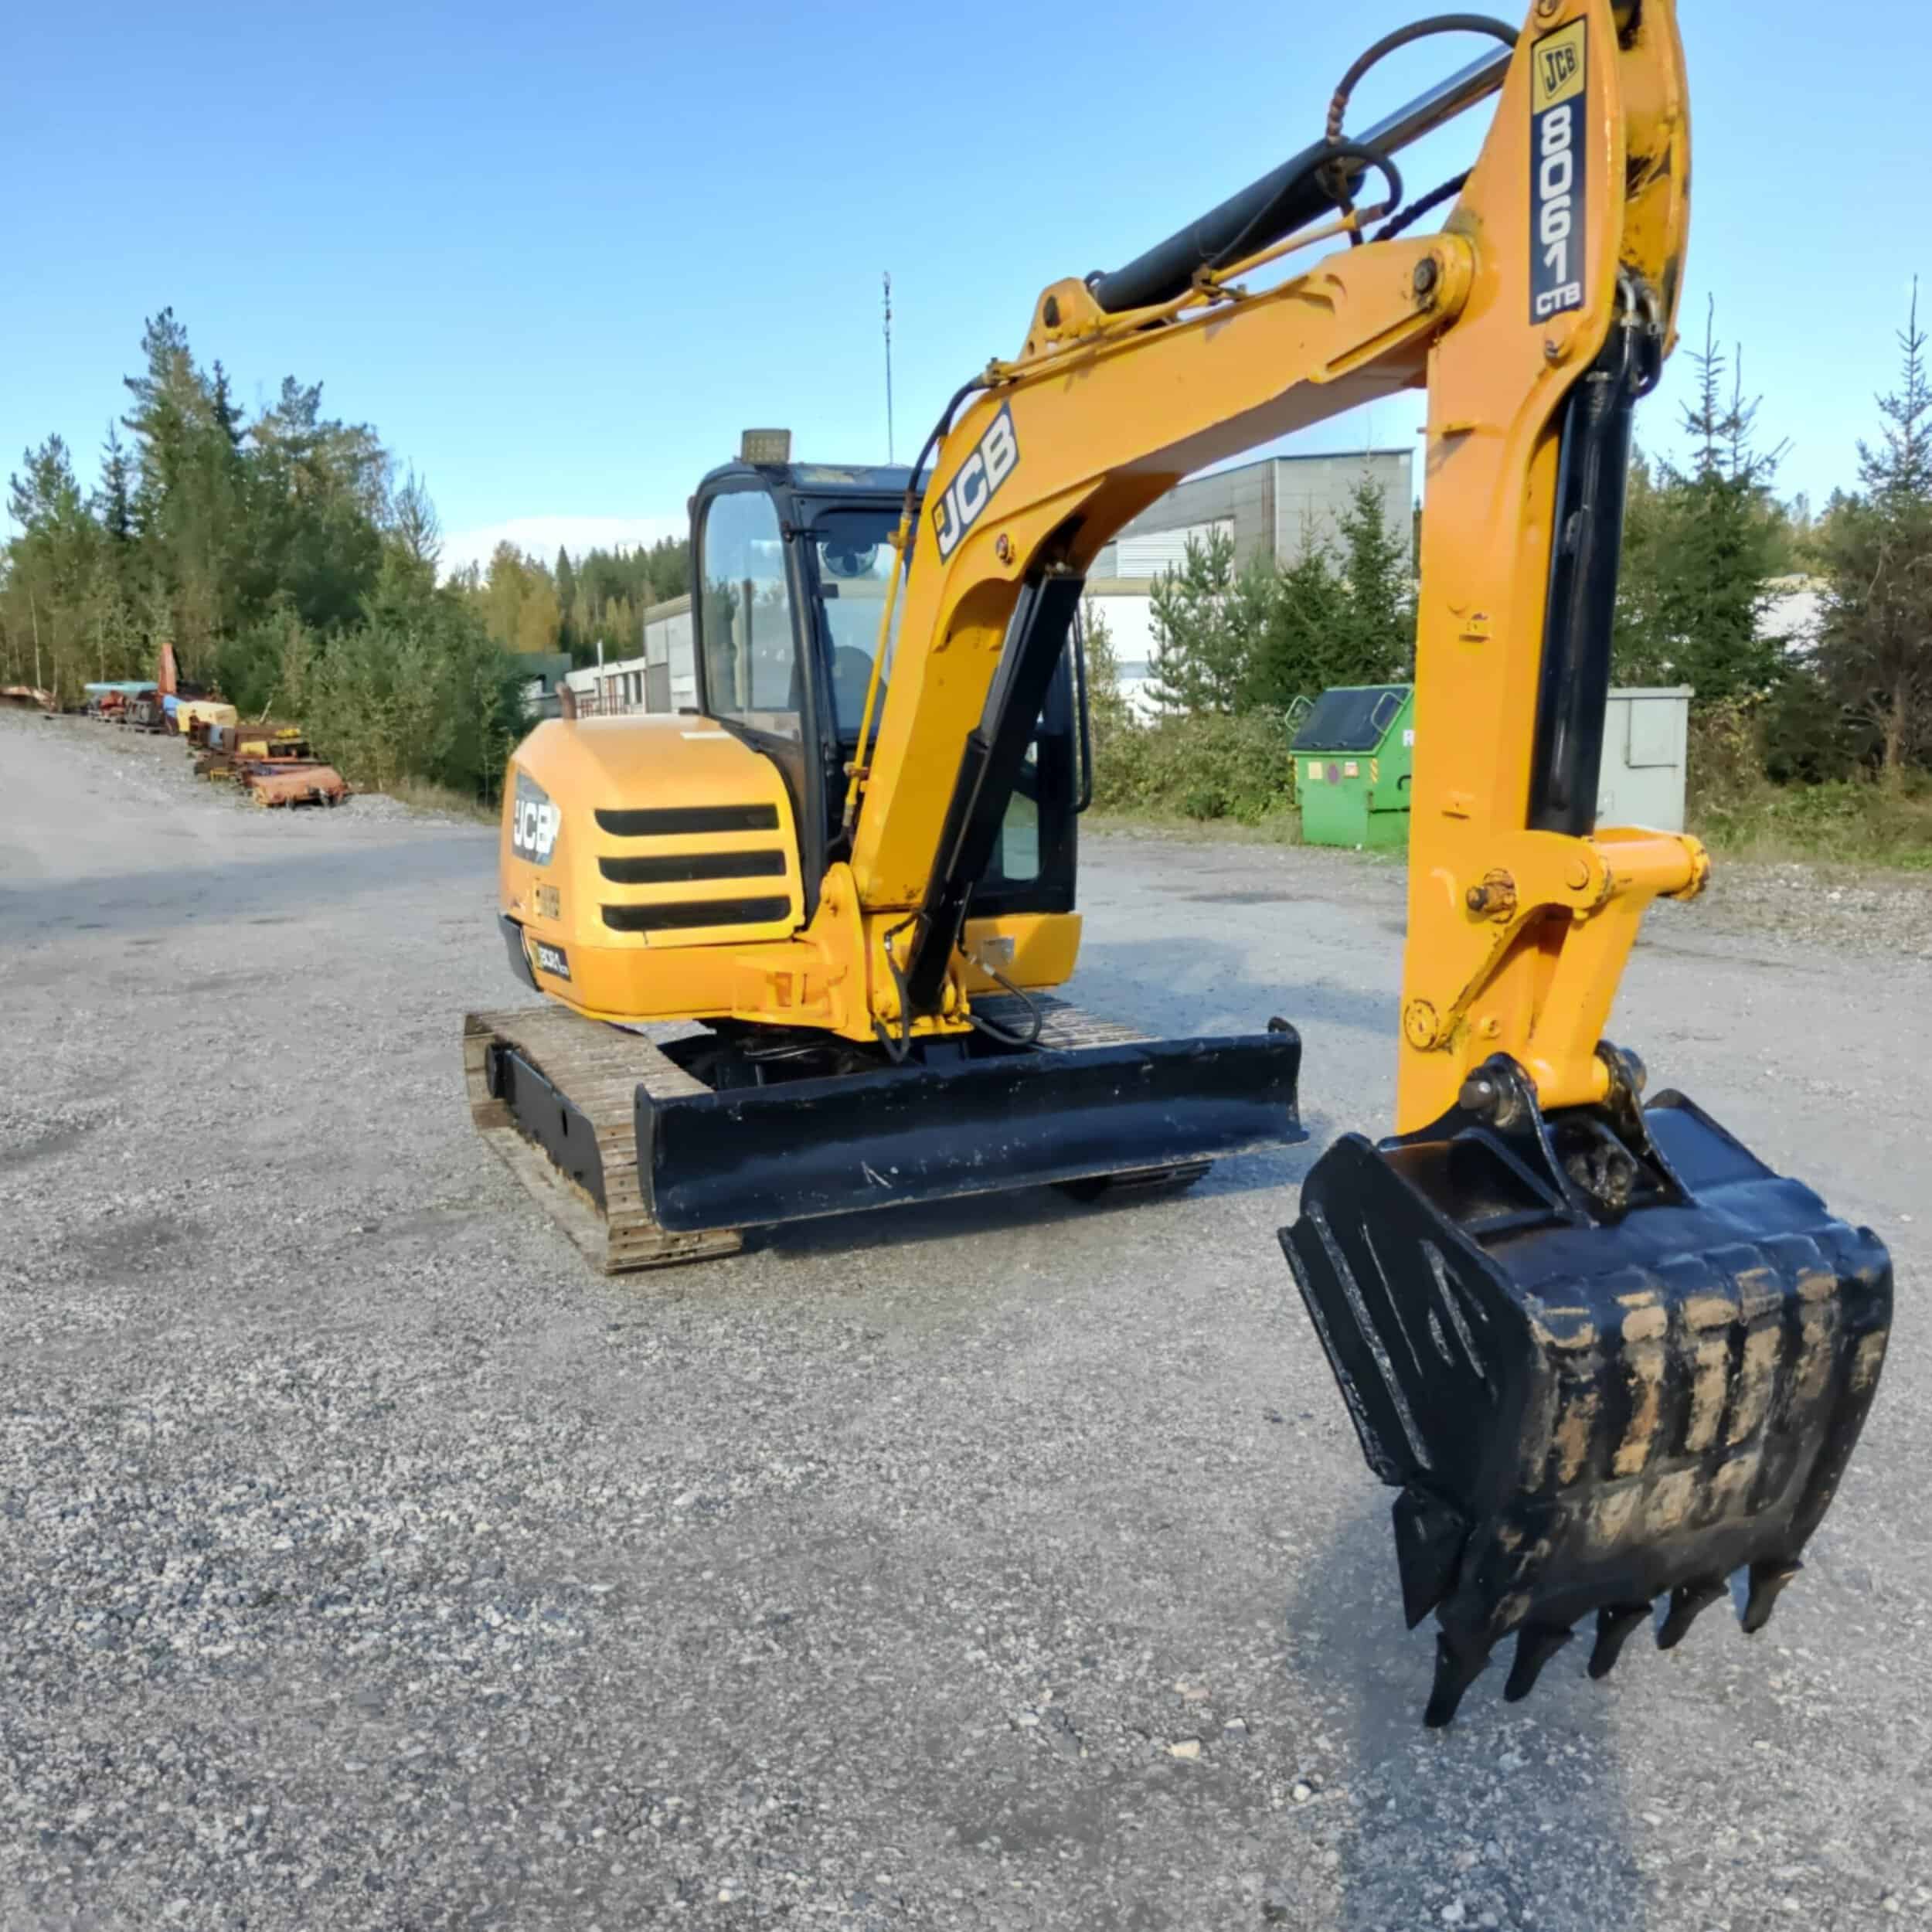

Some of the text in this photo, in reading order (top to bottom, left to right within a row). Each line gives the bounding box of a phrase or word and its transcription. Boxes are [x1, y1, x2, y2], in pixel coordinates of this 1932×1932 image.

[1546, 47, 1577, 92] JCB
[1539, 104, 1573, 284] 8061
[1536, 281, 1581, 315] CTB
[938, 413, 1017, 555] JCB
[514, 799, 556, 854] JCB
